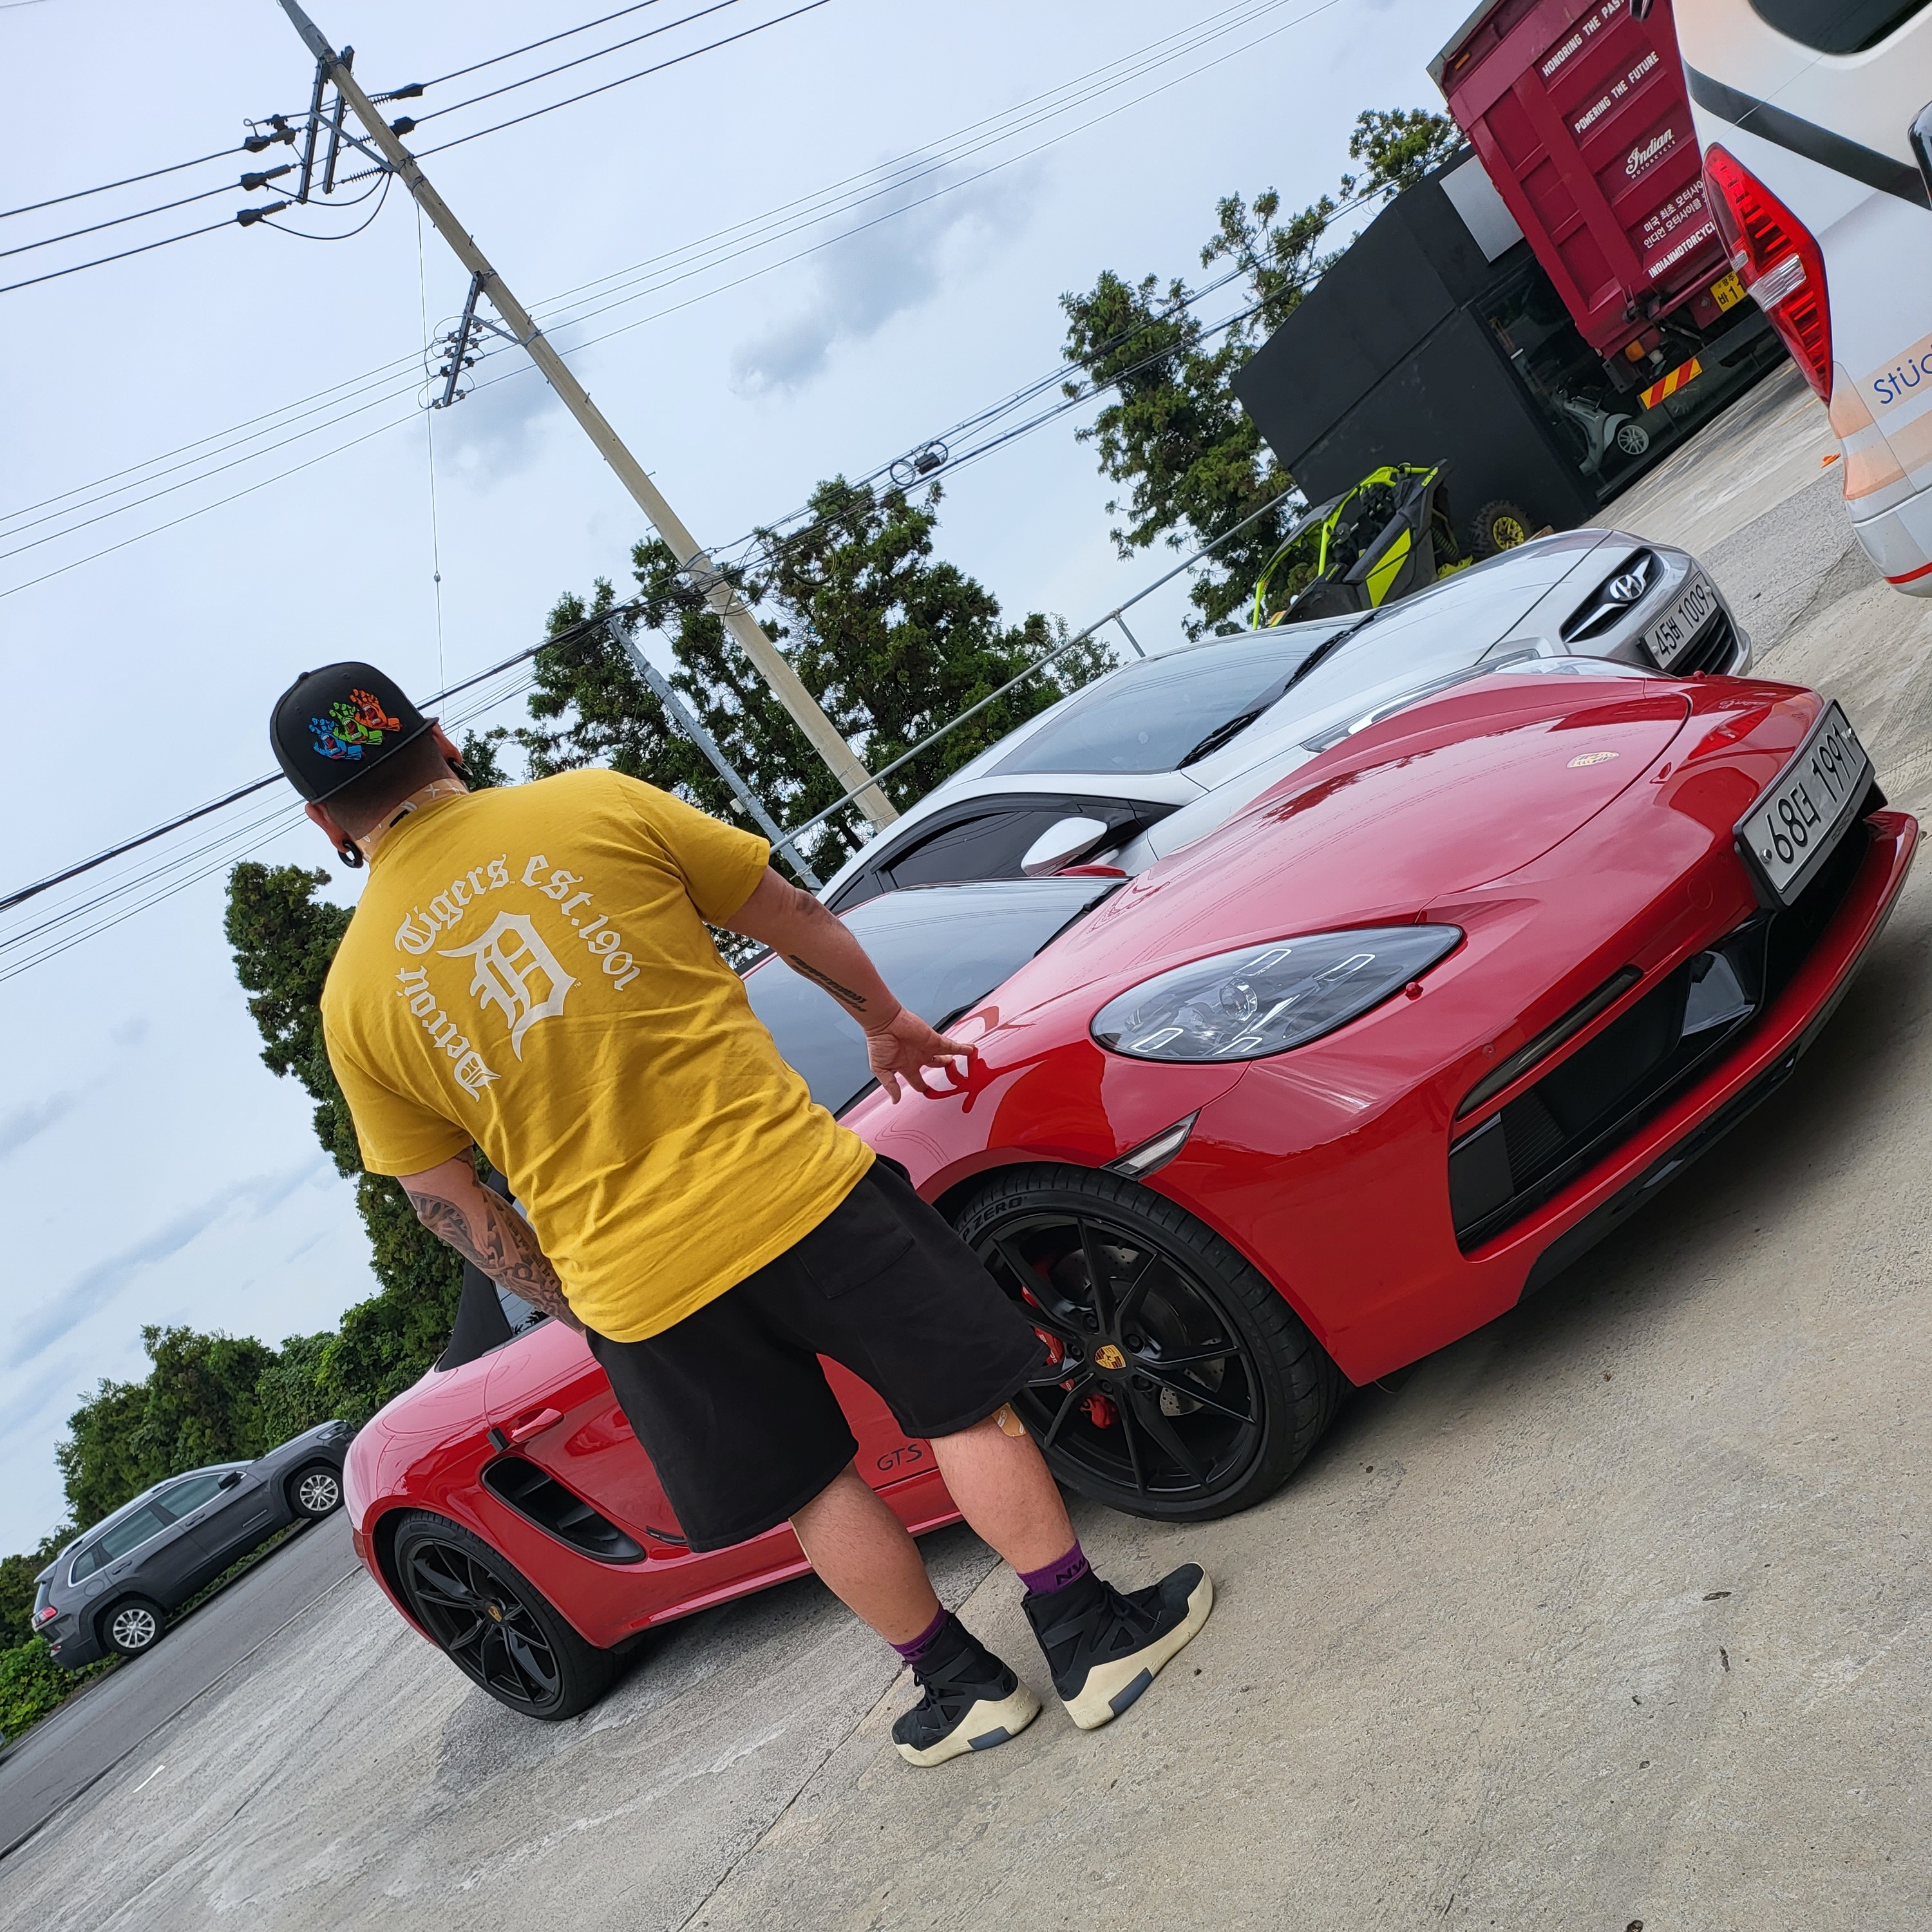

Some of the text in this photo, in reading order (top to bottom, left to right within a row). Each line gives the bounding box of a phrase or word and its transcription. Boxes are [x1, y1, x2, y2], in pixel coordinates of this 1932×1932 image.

[1542, 0, 1625, 77] HONORING THE PAS
[1574, 51, 1660, 133] POWERING THE FUTURE
[1625, 128, 1673, 175] Indian
[1631, 140, 1676, 179] MOTORCYCLE
[1643, 216, 1661, 232] 미국
[1660, 203, 1677, 220] 최초
[1643, 198, 1702, 249] 인디언 모터사이클
[1721, 274, 1736, 287] 광주
[1655, 584, 1710, 656] 45버 1009
[1766, 721, 1856, 864] 68더 1991
[1832, 806, 1854, 843] PORSCHE
[395, 854, 509, 955] Tigers
[436, 911, 578, 1063] D
[395, 966, 502, 1103] Detroit
[973, 1197, 1023, 1231] ZERO
[876, 1443, 923, 1471] GTS
